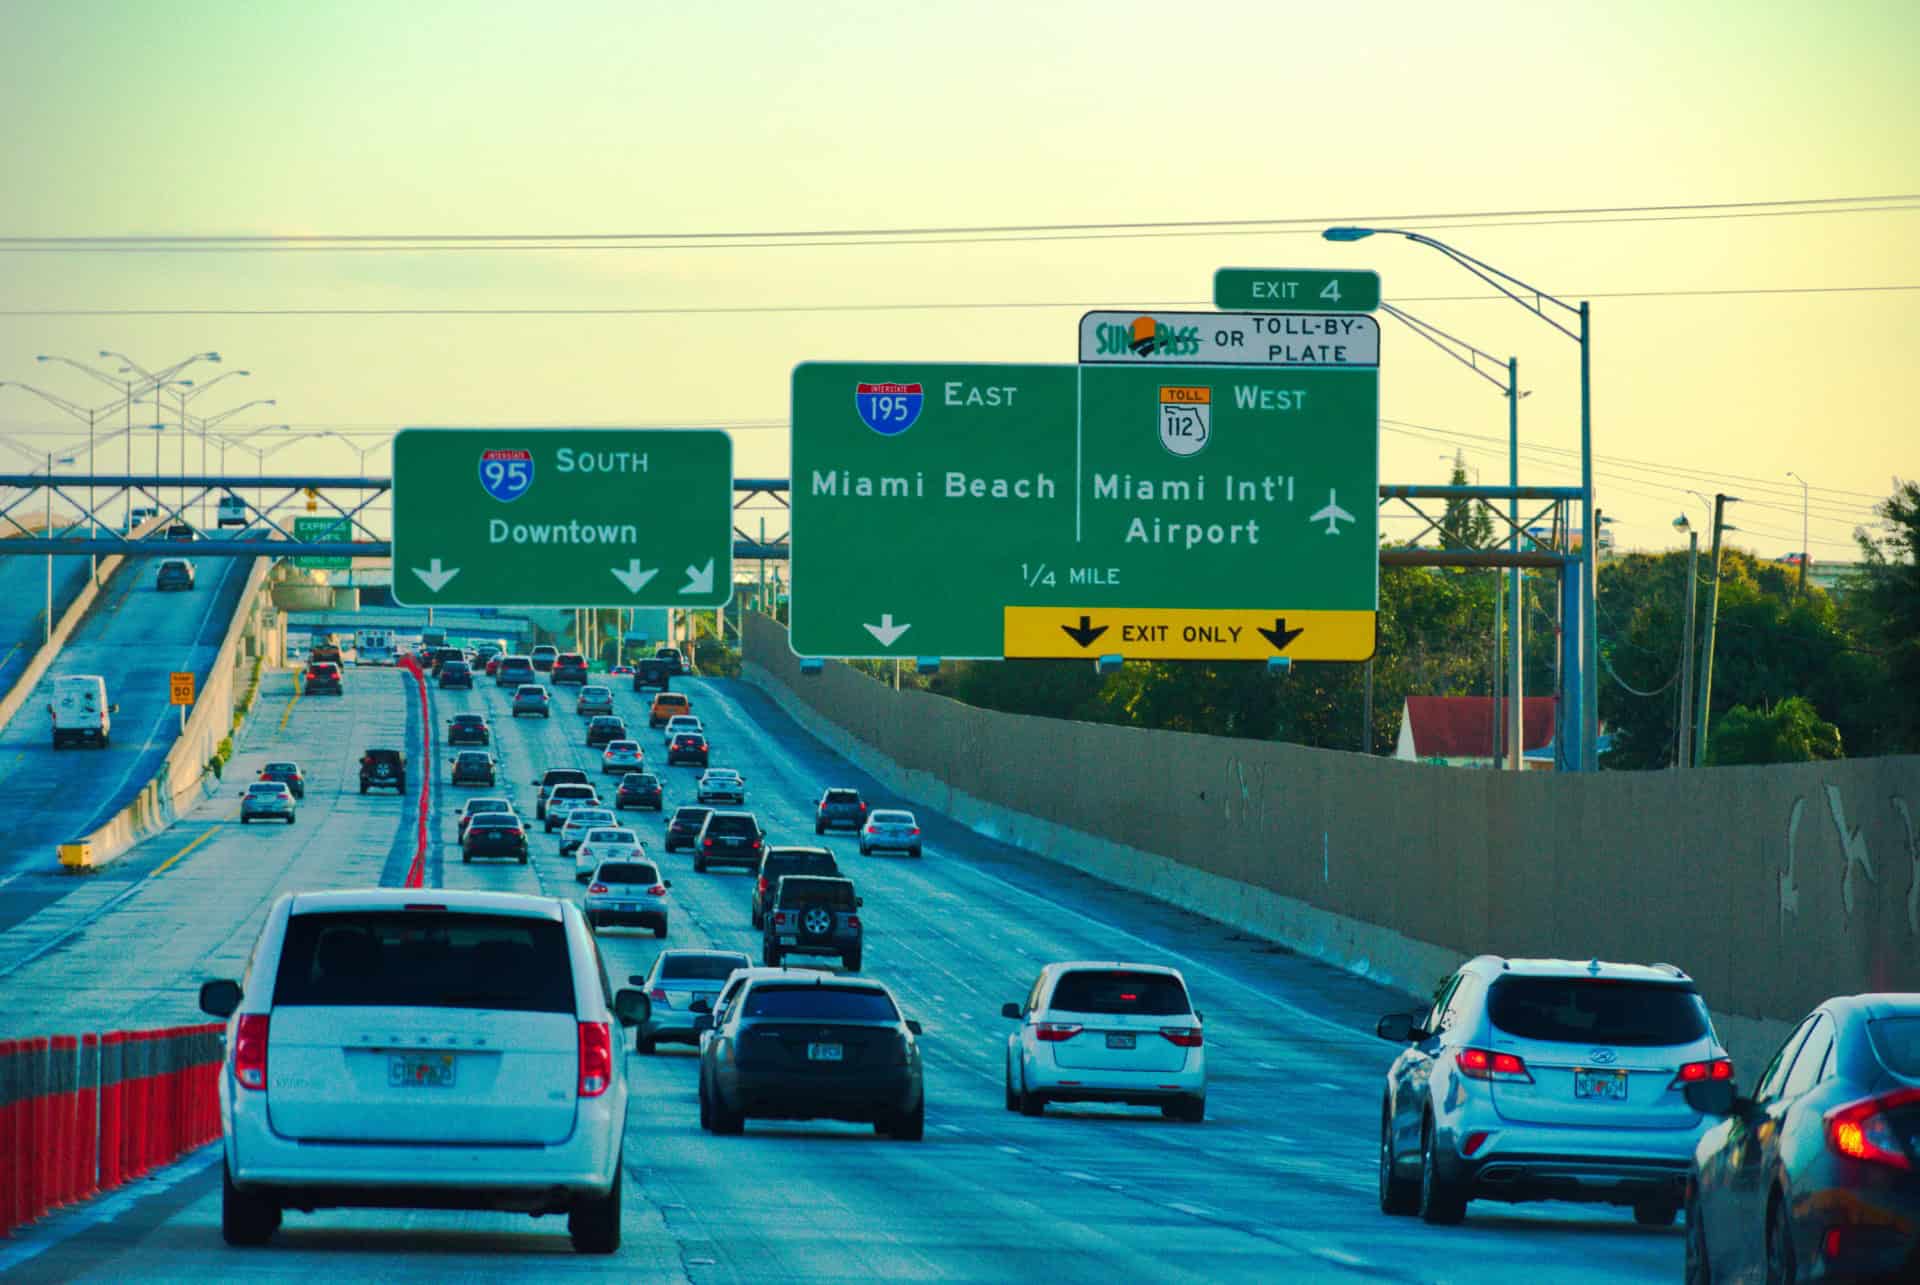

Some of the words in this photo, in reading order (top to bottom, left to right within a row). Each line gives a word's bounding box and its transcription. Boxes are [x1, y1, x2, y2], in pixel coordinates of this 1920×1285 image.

[1252, 281, 1299, 298] EXIT
[1320, 280, 1342, 301] 4
[1253, 317, 1364, 335] TOLL-BY-
[1215, 330, 1244, 347] OR
[1268, 345, 1347, 361] PLATE
[944, 382, 1018, 406] EAST
[1168, 389, 1203, 401] TOLL
[1234, 385, 1306, 410] WEST
[870, 397, 908, 421] 195
[1167, 416, 1193, 437] 112
[556, 447, 649, 472] SOUTH
[484, 462, 528, 491] 95
[811, 470, 924, 497] Miami
[945, 472, 1056, 498] Beach
[1093, 473, 1205, 500] Miami
[1226, 475, 1295, 501] Int'l
[488, 519, 638, 544] Downtown
[1125, 517, 1260, 550] Airport
[1021, 563, 1056, 588] 1/4
[1069, 567, 1120, 585] MILE
[1122, 625, 1168, 642] EXIT
[1183, 626, 1243, 643] ONLY
